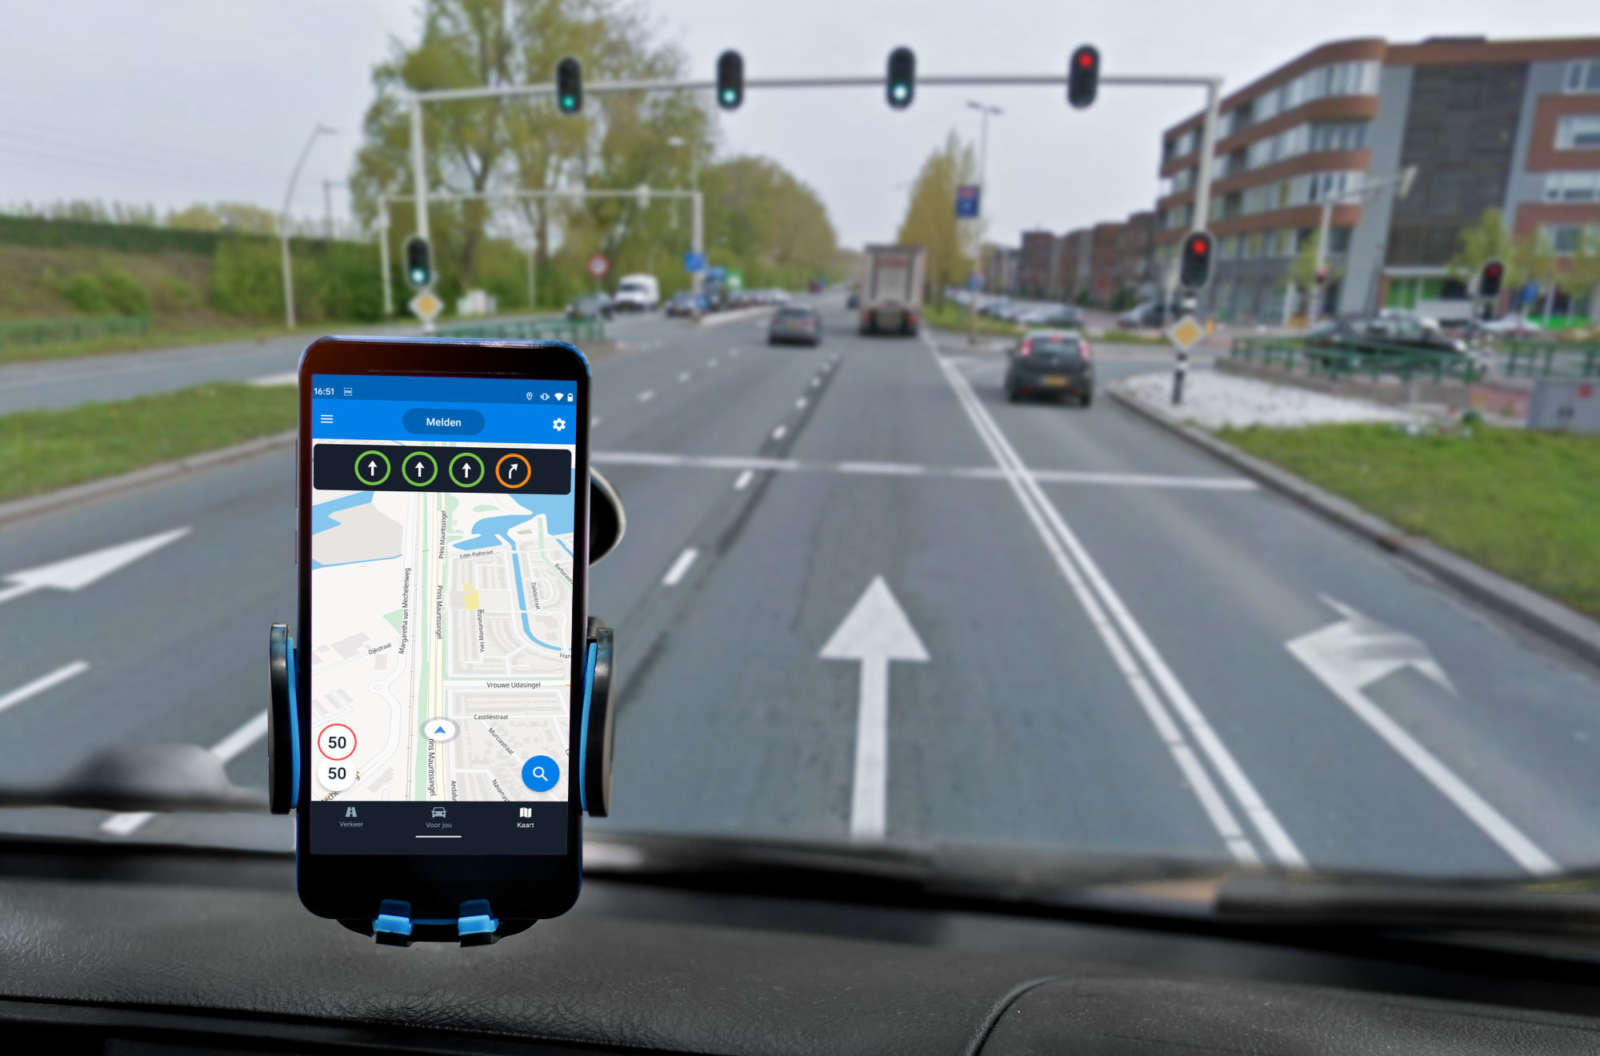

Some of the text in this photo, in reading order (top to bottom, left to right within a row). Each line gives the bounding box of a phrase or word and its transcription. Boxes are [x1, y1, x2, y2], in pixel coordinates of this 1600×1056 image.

[314, 387, 335, 396] 16:51
[426, 417, 462, 428] Melden
[487, 681, 541, 690] Vrouwe Udasingel
[328, 736, 347, 749] 50
[328, 767, 347, 780] 50
[441, 822, 452, 830] jou
